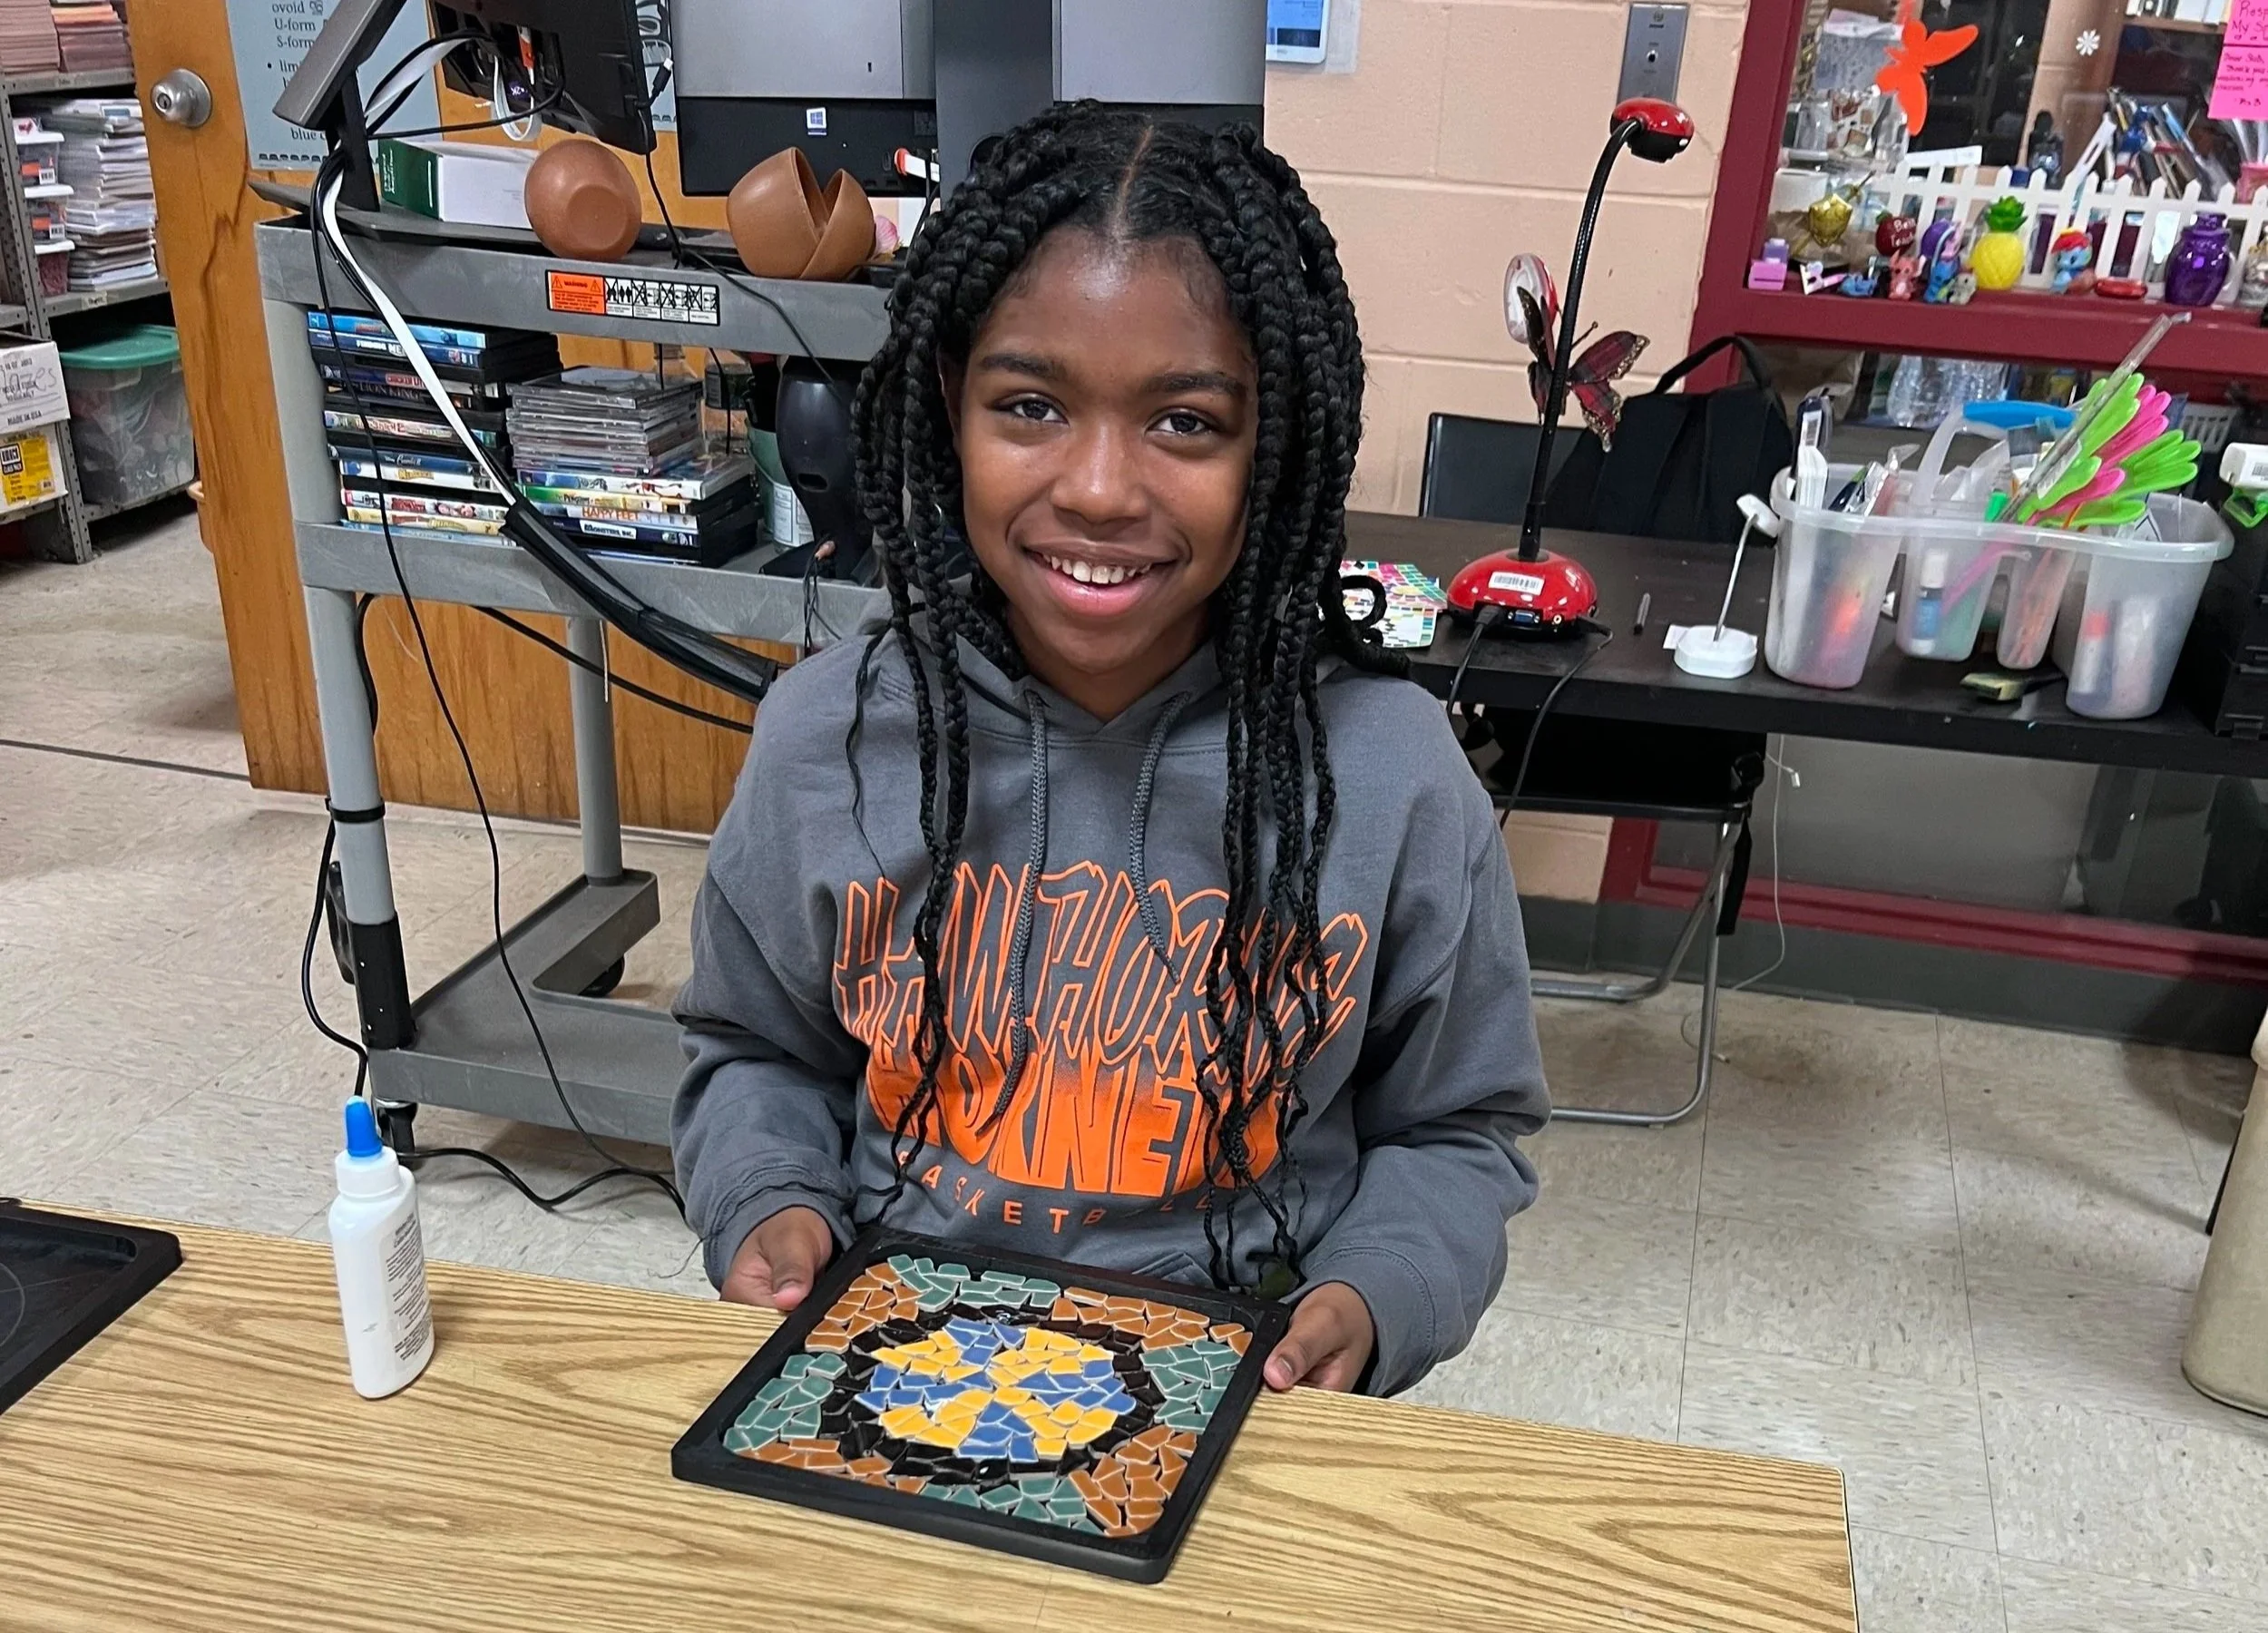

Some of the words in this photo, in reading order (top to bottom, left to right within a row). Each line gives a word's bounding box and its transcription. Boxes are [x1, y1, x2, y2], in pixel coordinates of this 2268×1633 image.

[272, 2, 305, 14] ovoid
[275, 18, 316, 31] U-form
[279, 60, 302, 73] lim
[291, 128, 317, 140] blue
[563, 280, 589, 288] WARNING
[389, 344, 408, 357] NE
[582, 506, 615, 519] HAPPY
[616, 510, 639, 522] FEET
